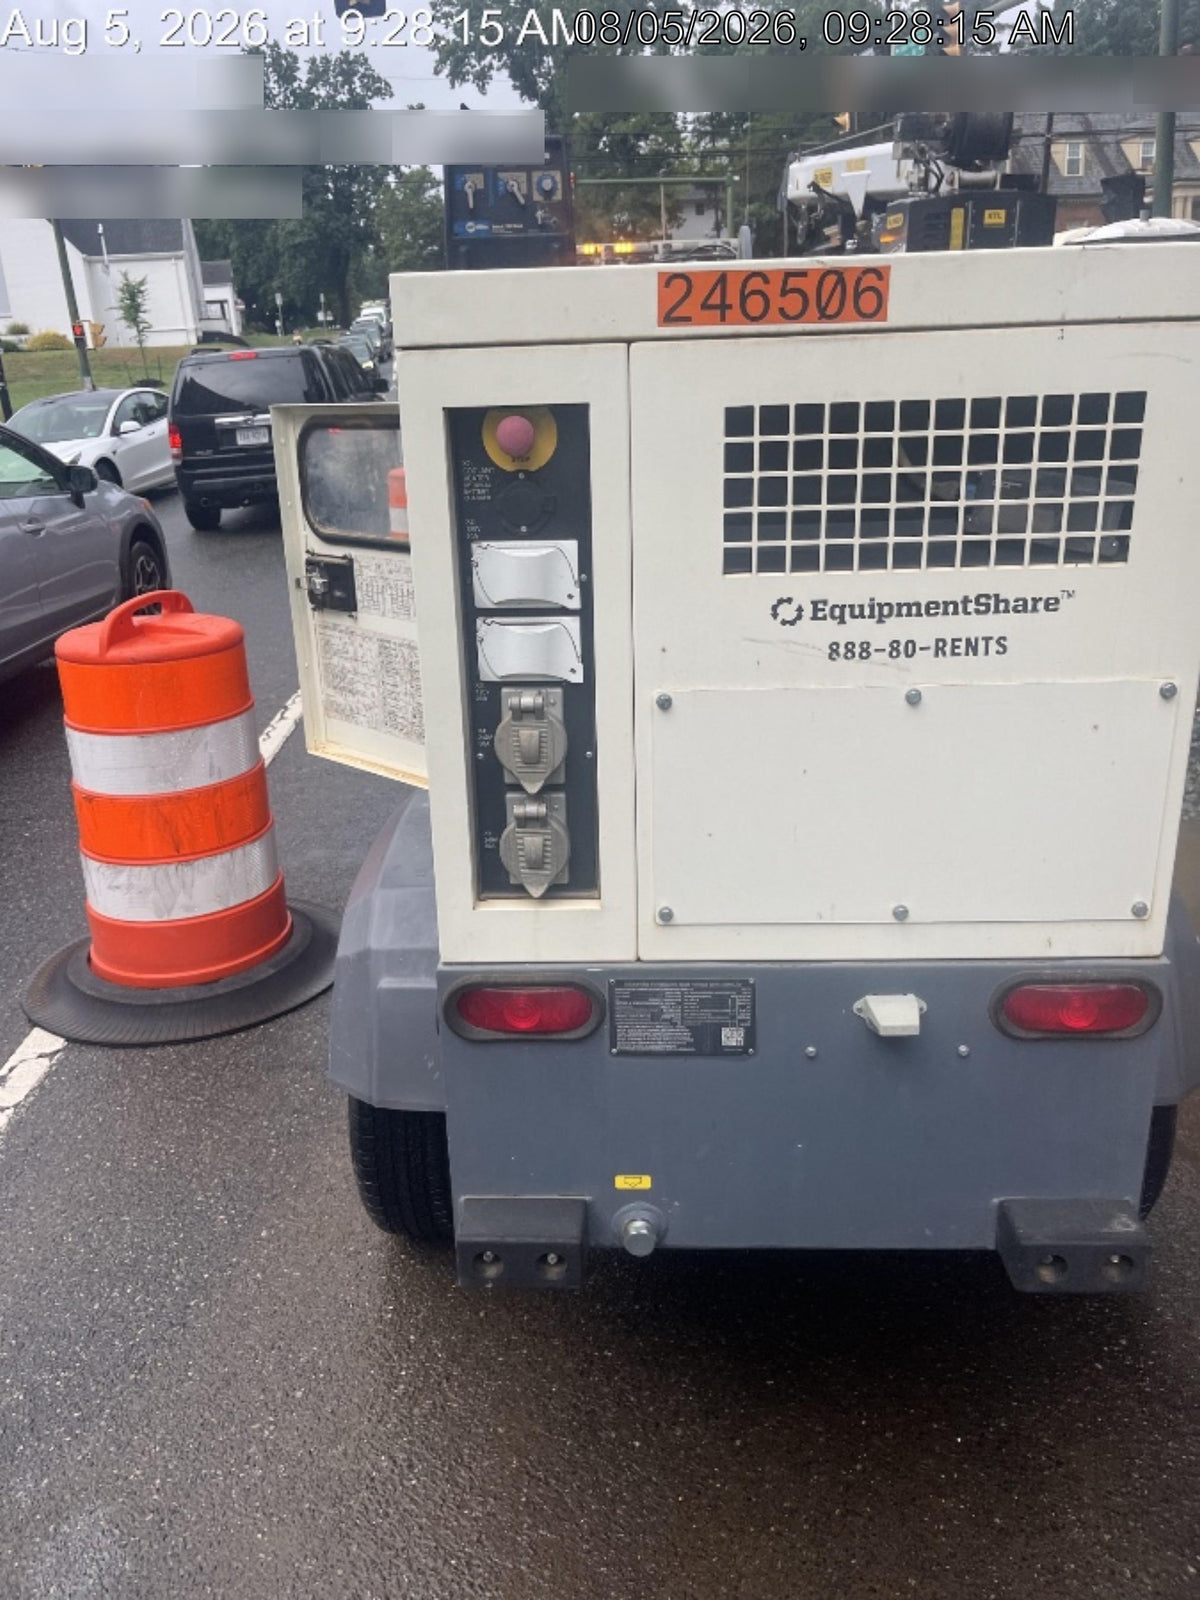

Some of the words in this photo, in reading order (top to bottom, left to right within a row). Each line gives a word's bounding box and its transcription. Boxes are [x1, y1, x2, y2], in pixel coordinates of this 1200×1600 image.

[662, 271, 884, 323] 246506
[810, 594, 1061, 624] EquipmentShare
[828, 636, 1008, 661] 888-80-RENTS
